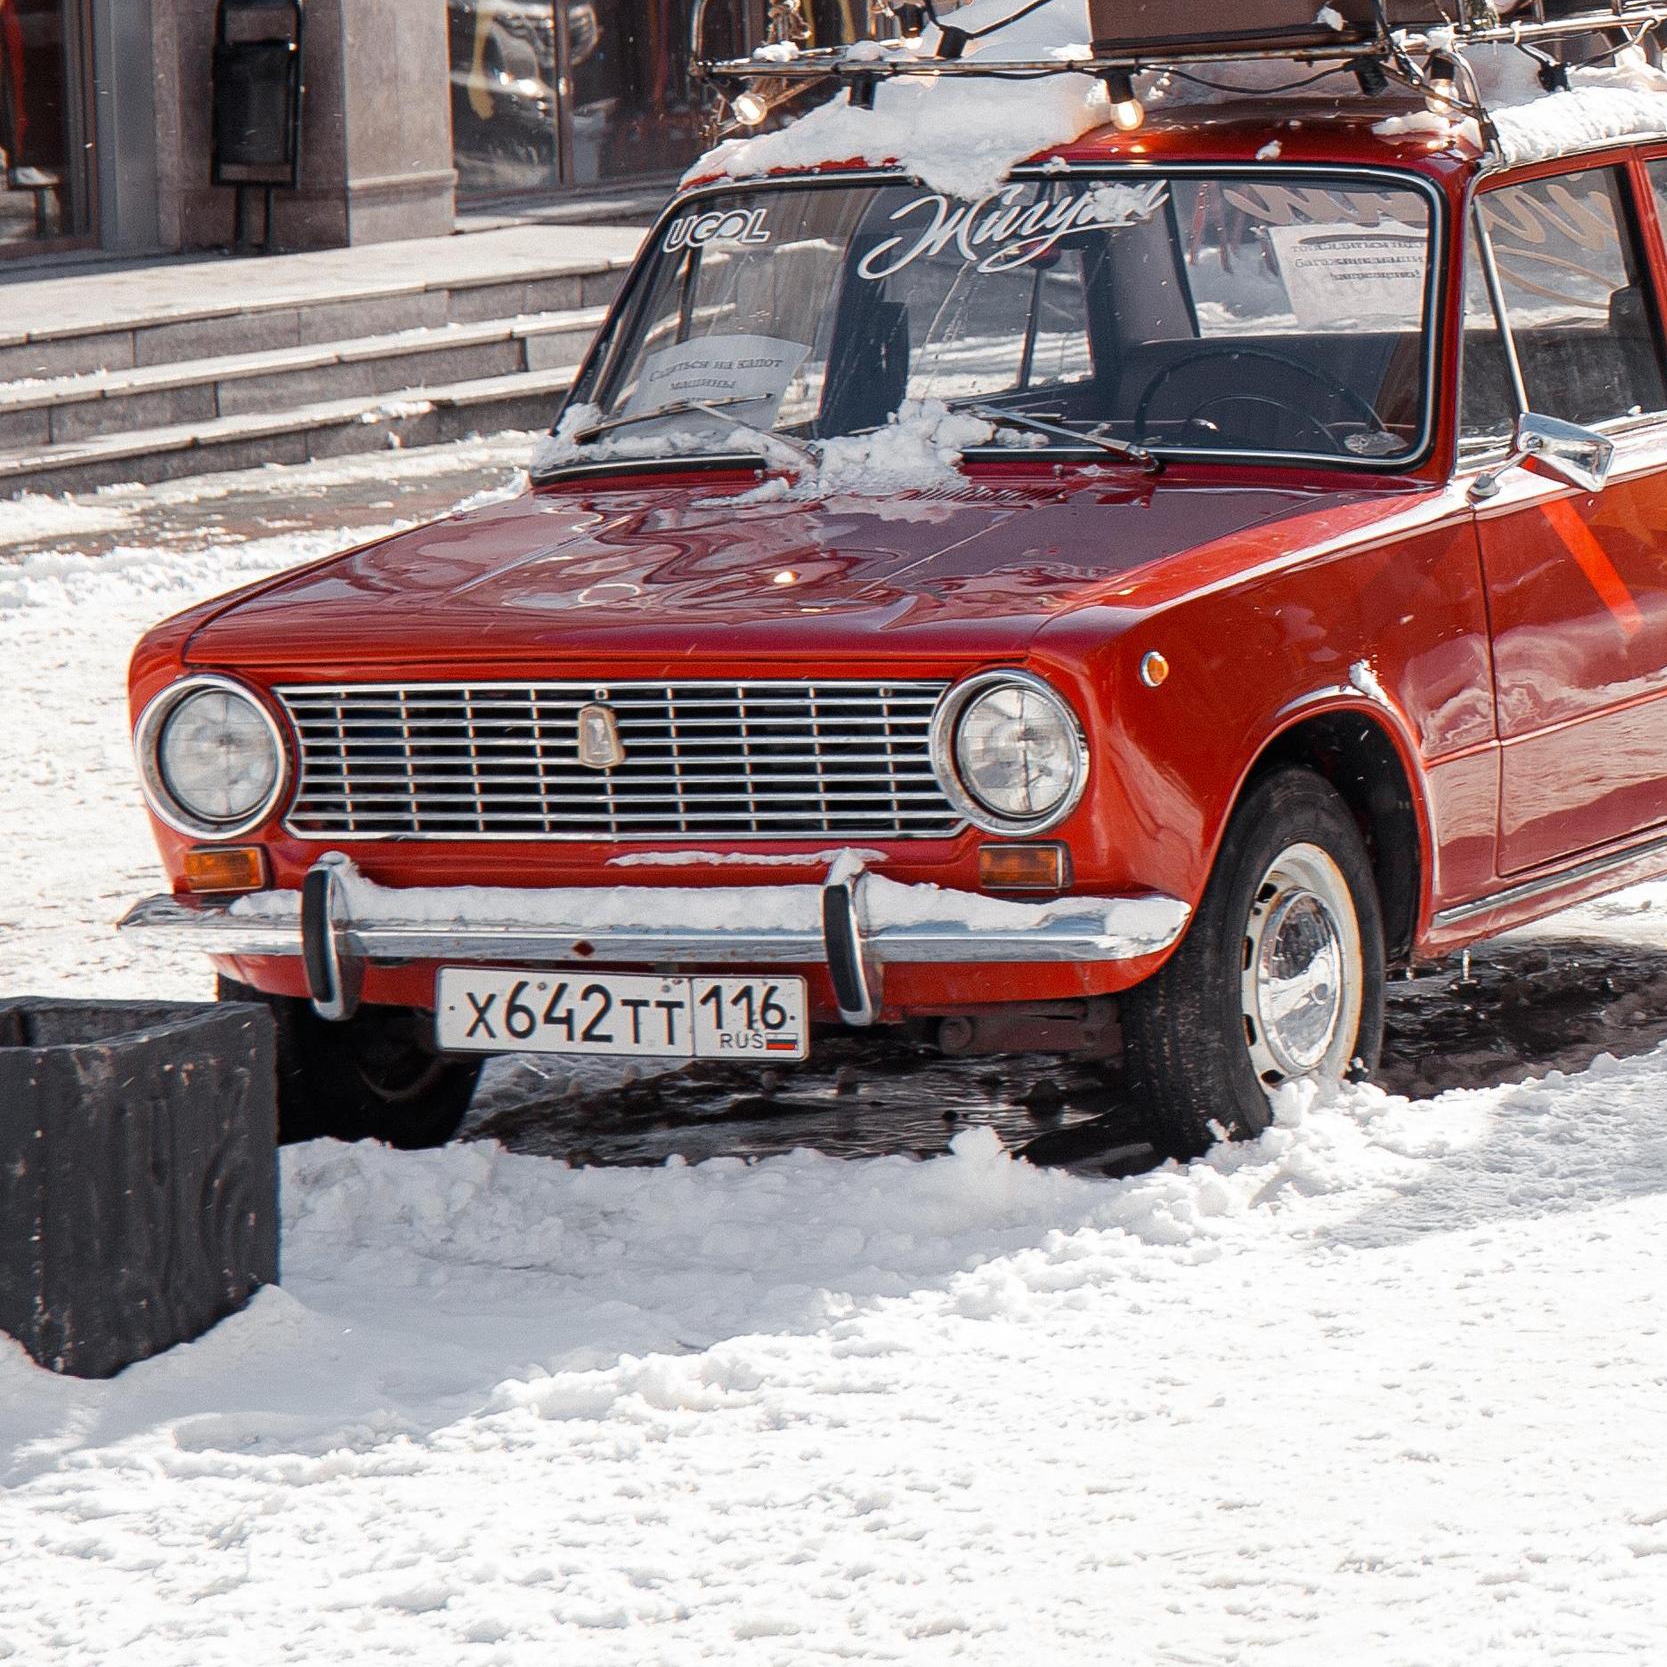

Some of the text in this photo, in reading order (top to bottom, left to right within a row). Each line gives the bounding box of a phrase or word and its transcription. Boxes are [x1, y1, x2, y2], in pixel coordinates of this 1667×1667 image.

[857, 179, 1170, 280] Жигуи
[698, 984, 787, 1031] 116
[719, 1032, 764, 1050] RUS
